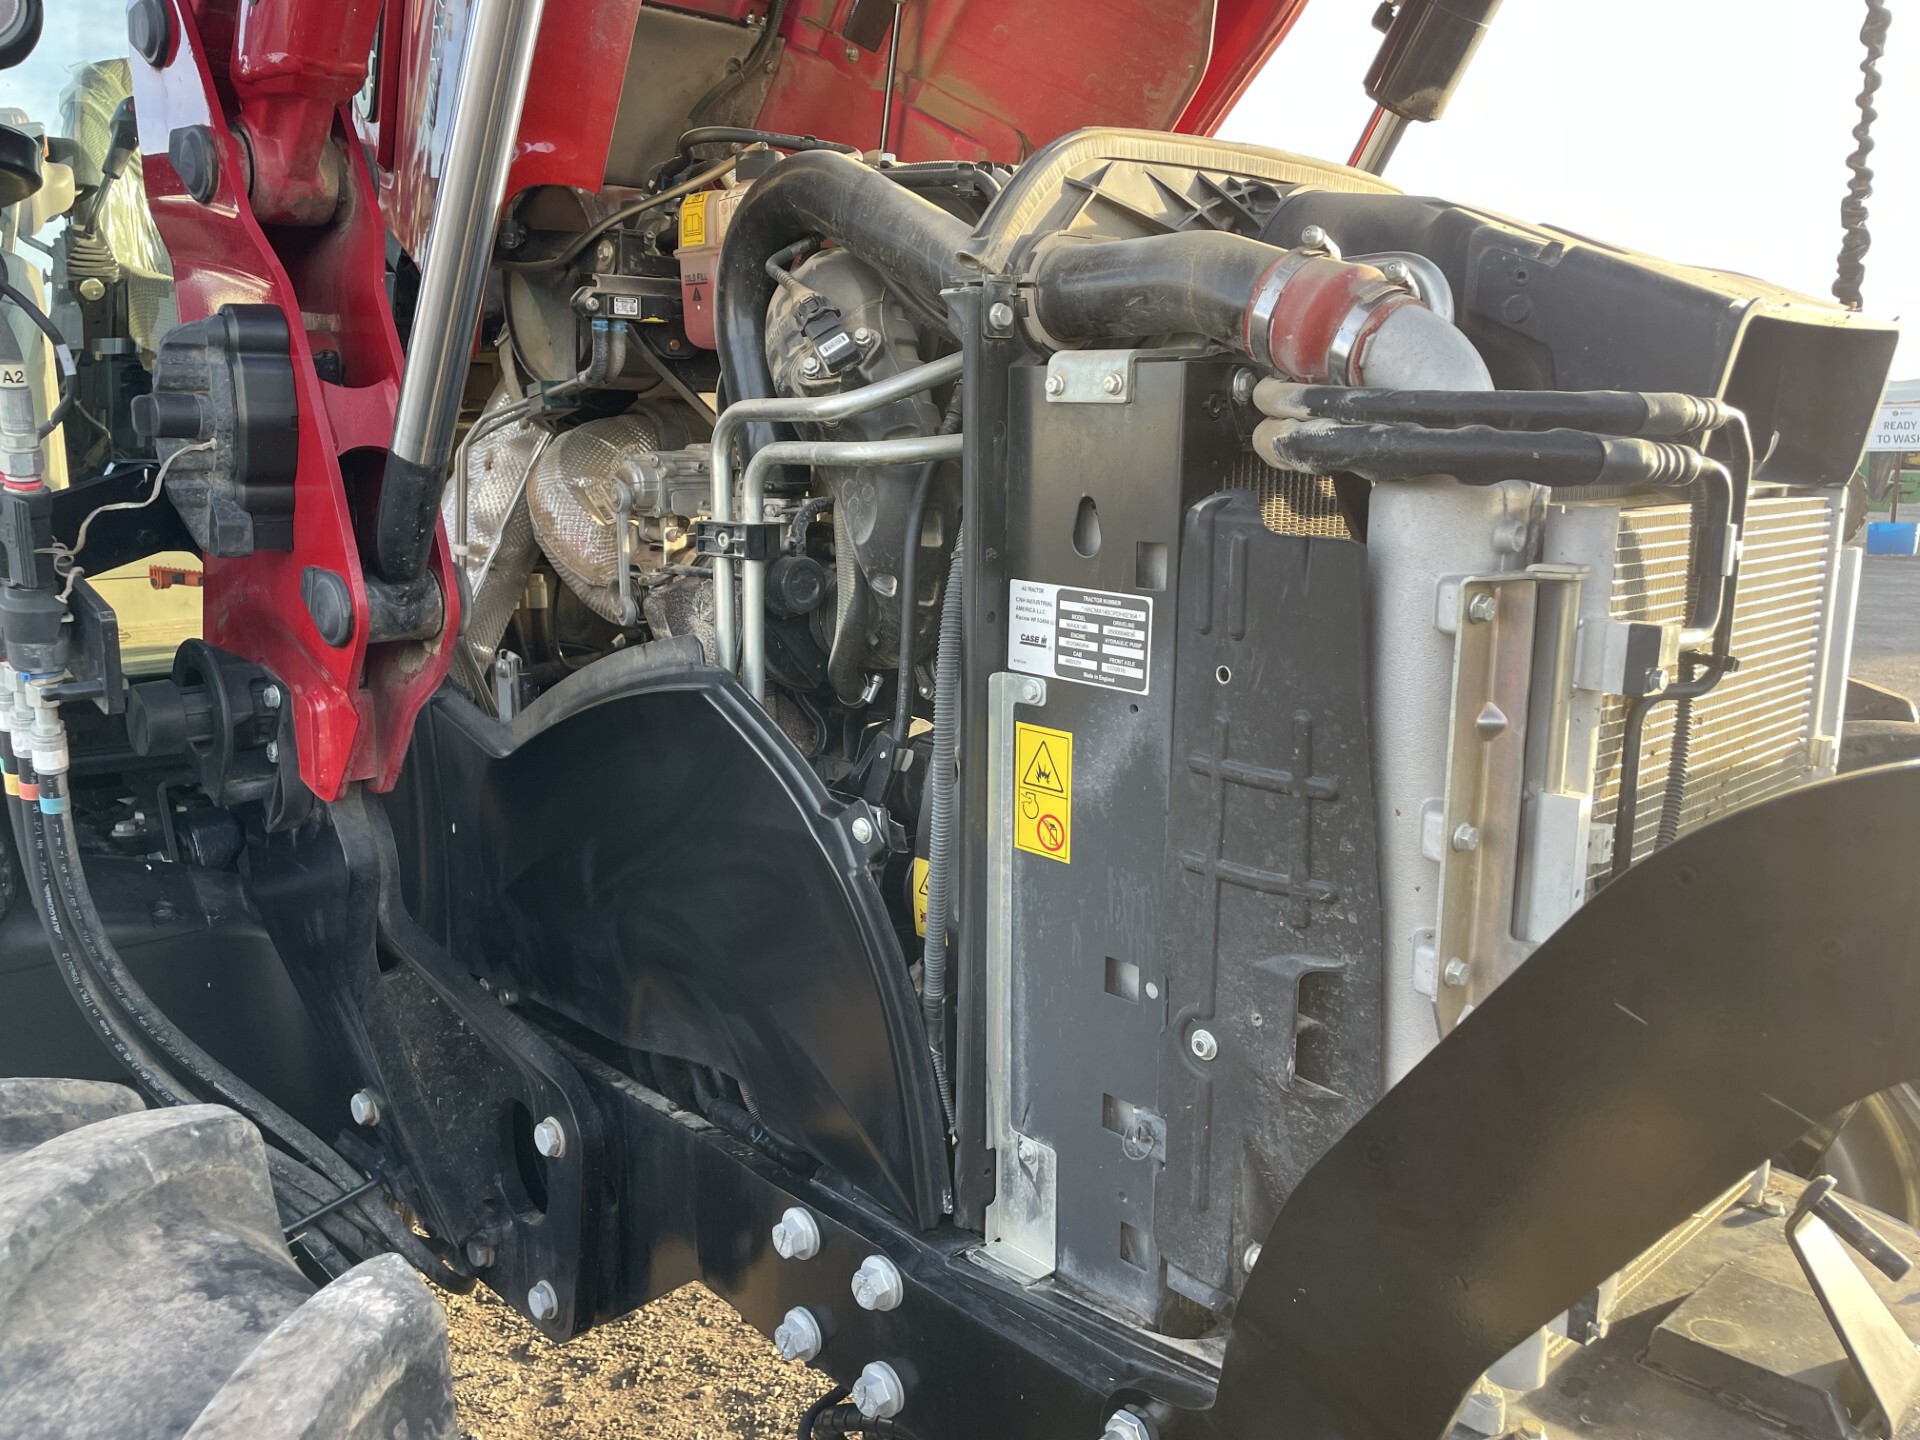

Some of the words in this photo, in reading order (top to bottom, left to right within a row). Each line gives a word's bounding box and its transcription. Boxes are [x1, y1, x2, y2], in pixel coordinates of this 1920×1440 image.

[697, 273, 708, 281] FILL
[2, 370, 25, 384] A2
[1883, 421, 1918, 431] READY
[1876, 435, 1891, 444] TO
[1026, 597, 1053, 607] INDUSTRIAL
[1082, 595, 1103, 605] TRACTOR
[1102, 598, 1122, 606] NUMBER
[1015, 606, 1036, 614] AMERICA
[1071, 613, 1087, 622] MODEL
[1112, 620, 1136, 629] DRIVELINE
[1020, 632, 1040, 644] CASE
[1070, 632, 1087, 640] ENGINE
[1104, 638, 1129, 648] HYDRAULIC
[1128, 641, 1143, 649] PUMP
[1072, 650, 1083, 658] CAB
[1109, 657, 1124, 665] FRONT
[1124, 659, 1136, 667] AXLE
[1083, 671, 1094, 679] Made
[1098, 673, 1115, 684] England
[77, 987, 93, 1007] ITALY
[98, 1019, 112, 1036] Made
